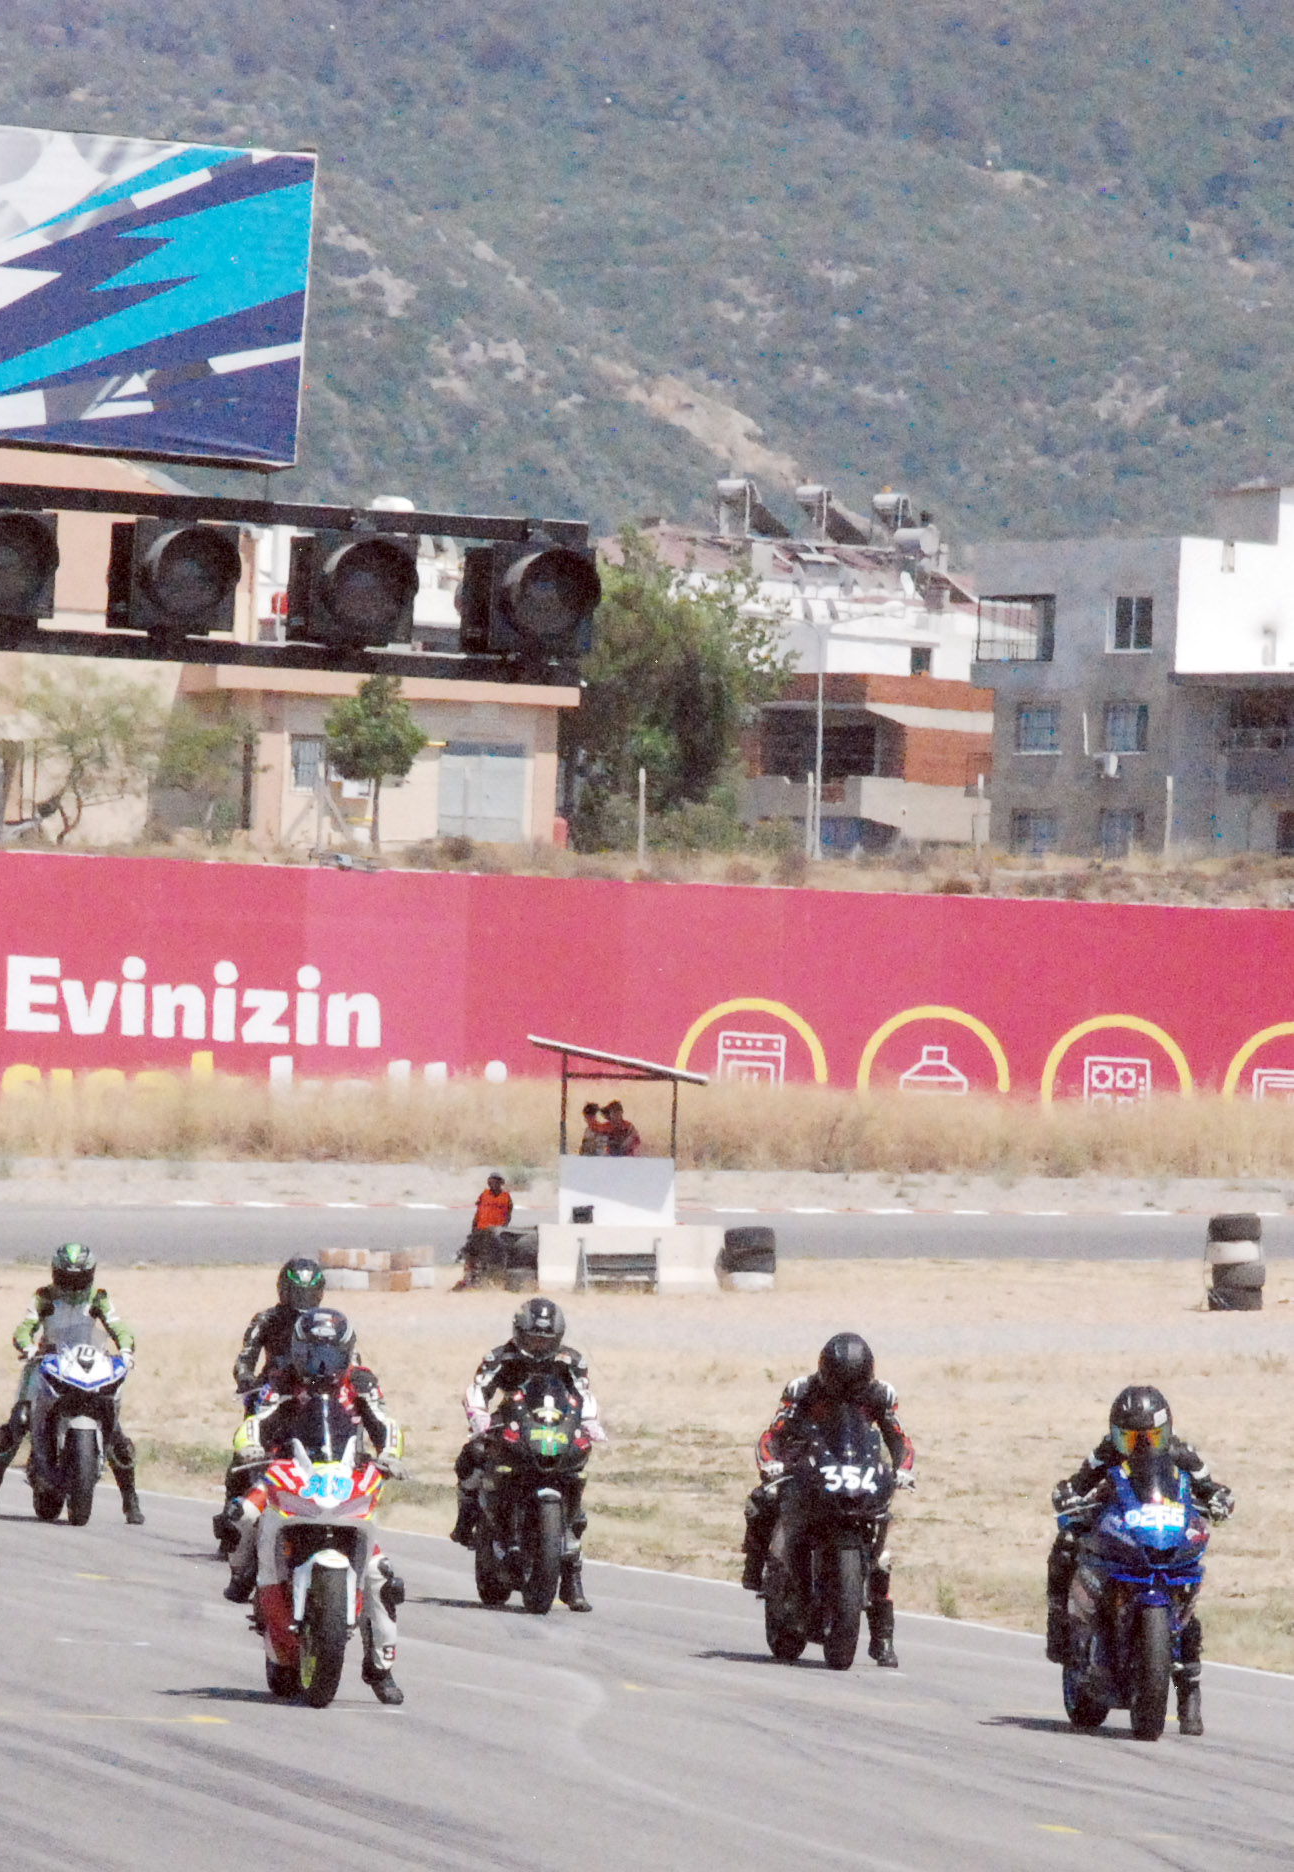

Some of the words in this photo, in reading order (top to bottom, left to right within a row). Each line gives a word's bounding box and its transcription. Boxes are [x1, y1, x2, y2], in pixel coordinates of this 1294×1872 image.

[6, 954, 382, 1049] Evinizin
[76, 1345, 97, 1358] 10
[819, 1464, 878, 1494] 354
